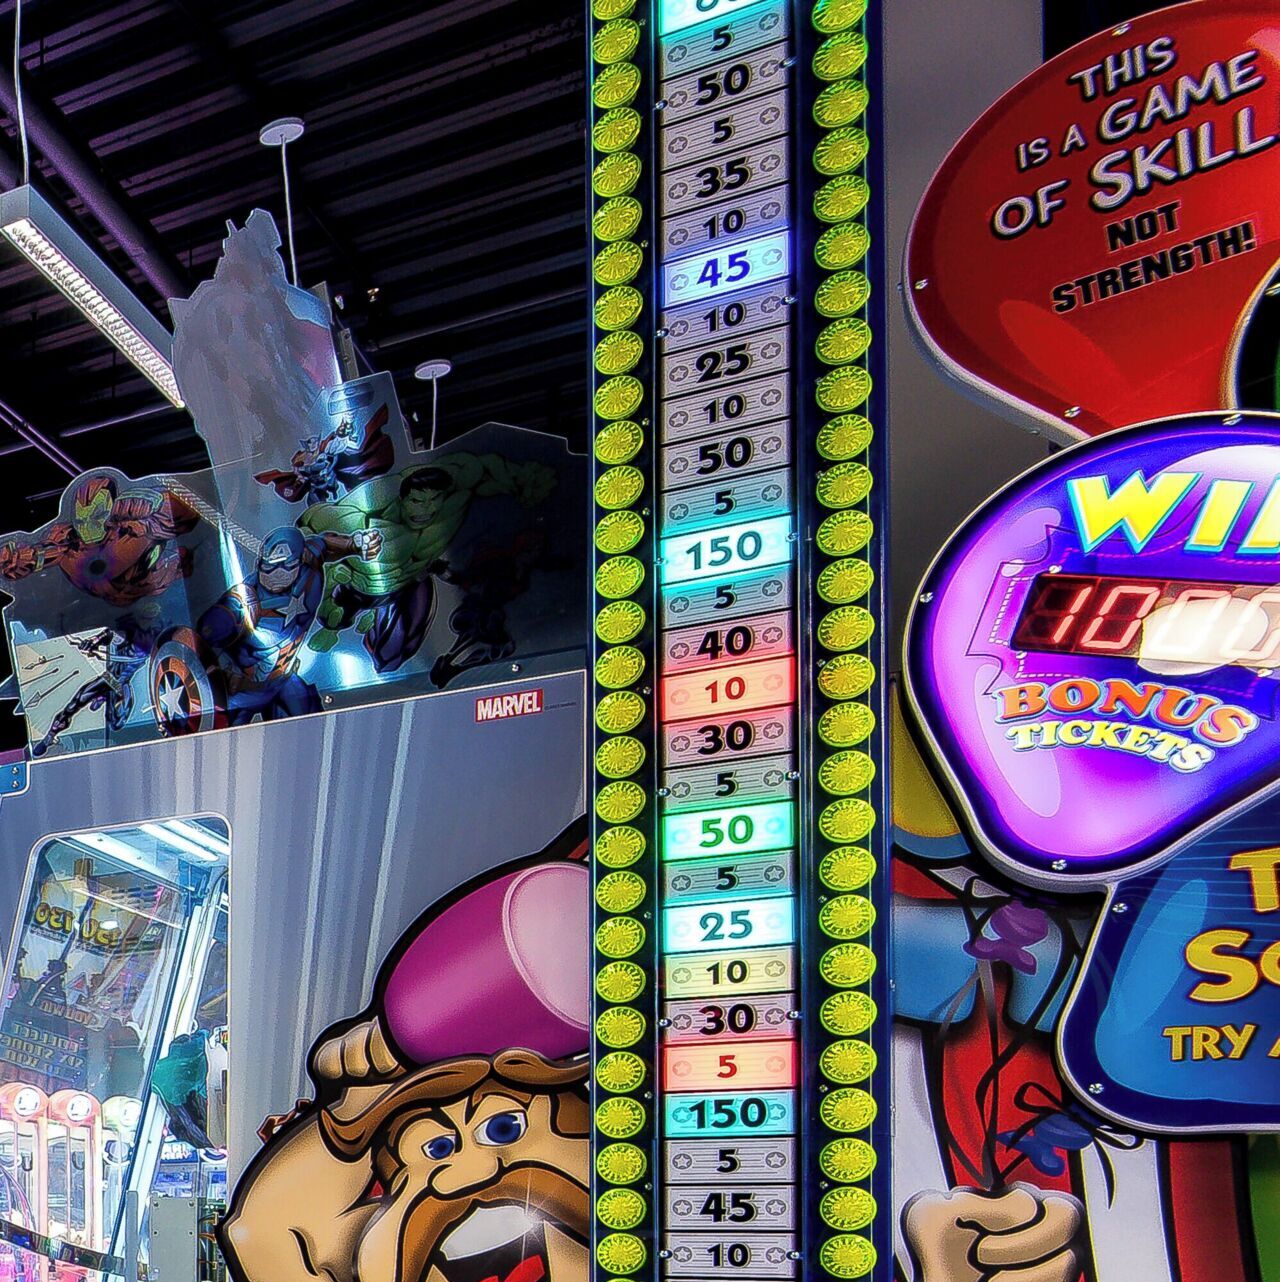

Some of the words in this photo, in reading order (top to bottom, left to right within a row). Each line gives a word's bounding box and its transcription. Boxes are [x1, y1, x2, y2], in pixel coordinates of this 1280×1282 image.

[712, 25, 734, 51] 5
[1070, 36, 1176, 99] THIS
[696, 63, 750, 106] 50
[1016, 137, 1050, 171] IS
[1060, 124, 1088, 155] A
[1099, 50, 1264, 142] GAME
[712, 118, 734, 144] 5
[695, 157, 750, 198] 35
[703, 208, 744, 240] 10
[992, 179, 1070, 238] OF
[1105, 201, 1182, 254] NOT
[697, 250, 750, 288] 45
[1051, 222, 1257, 315] STRENGTH!
[703, 302, 744, 332] 10
[696, 346, 750, 384] 25
[703, 395, 745, 424] 10
[696, 437, 751, 475] 50
[713, 490, 735, 515] 5
[686, 531, 761, 570] 150
[713, 585, 736, 609] 5
[696, 626, 752, 661] 40
[476, 691, 541, 721] MARVEL
[705, 676, 745, 704] 10
[993, 679, 1260, 747] BONUS
[697, 720, 753, 755] 30
[1007, 720, 1214, 773] TICKETS
[714, 771, 737, 796] 5
[699, 815, 753, 848] 50
[716, 866, 737, 890] 5
[699, 910, 752, 941] 25
[706, 960, 747, 985] 10
[698, 1005, 754, 1036] 30
[1162, 1024, 1258, 1061] TRY
[716, 1055, 737, 1078] 5
[689, 1097, 767, 1129] 150
[716, 1149, 738, 1172] 5
[700, 1193, 756, 1223] 45
[707, 1243, 750, 1267] 10
